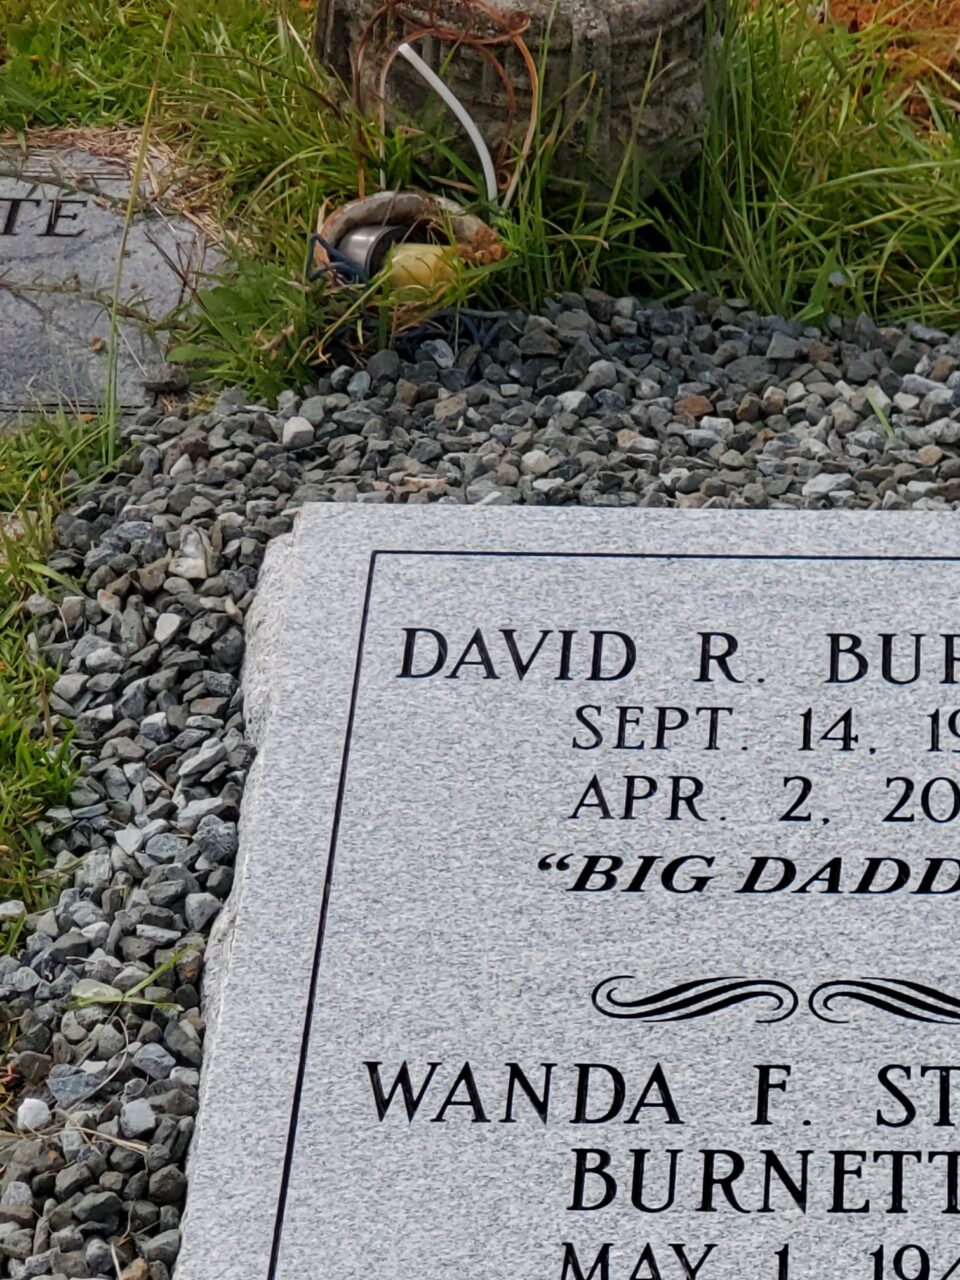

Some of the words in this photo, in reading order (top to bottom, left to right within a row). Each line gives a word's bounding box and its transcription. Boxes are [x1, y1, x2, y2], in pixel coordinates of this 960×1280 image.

[395, 627, 637, 682] DAVID
[693, 631, 765, 684] R.
[572, 704, 748, 751] SEPT.
[798, 707, 877, 755] 14,
[567, 774, 728, 822] APR.
[778, 775, 830, 826] 2,
[537, 852, 716, 894] “BIG
[362, 1060, 685, 1125] WANDA
[750, 1064, 812, 1127] F.
